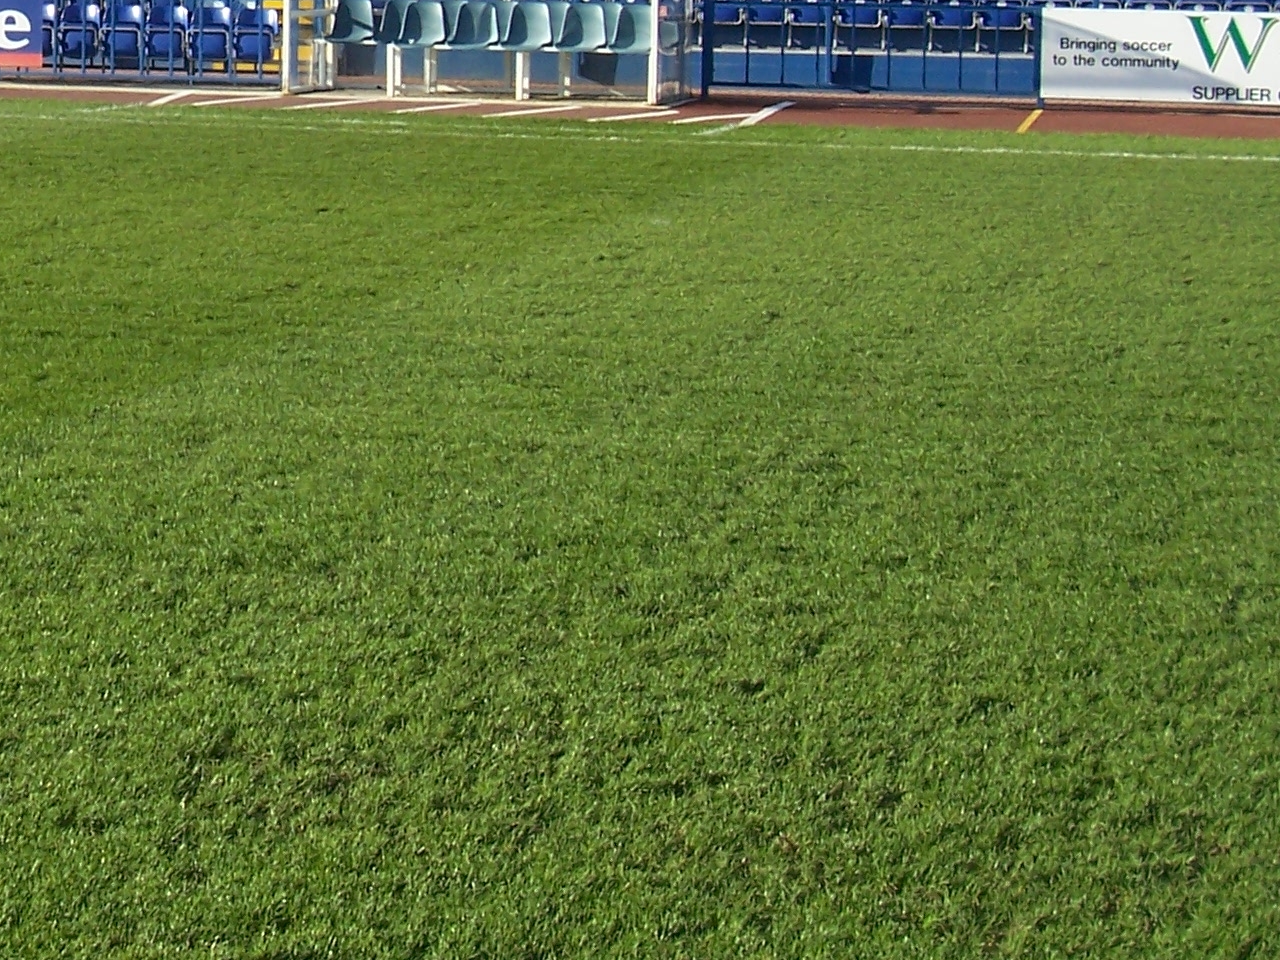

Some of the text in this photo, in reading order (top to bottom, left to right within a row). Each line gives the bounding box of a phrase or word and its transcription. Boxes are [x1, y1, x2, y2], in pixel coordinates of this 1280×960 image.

[1060, 37, 1173, 53] Bringing soccer
[1053, 54, 1180, 71] to the community
[1192, 85, 1271, 102] SUPPLIER
